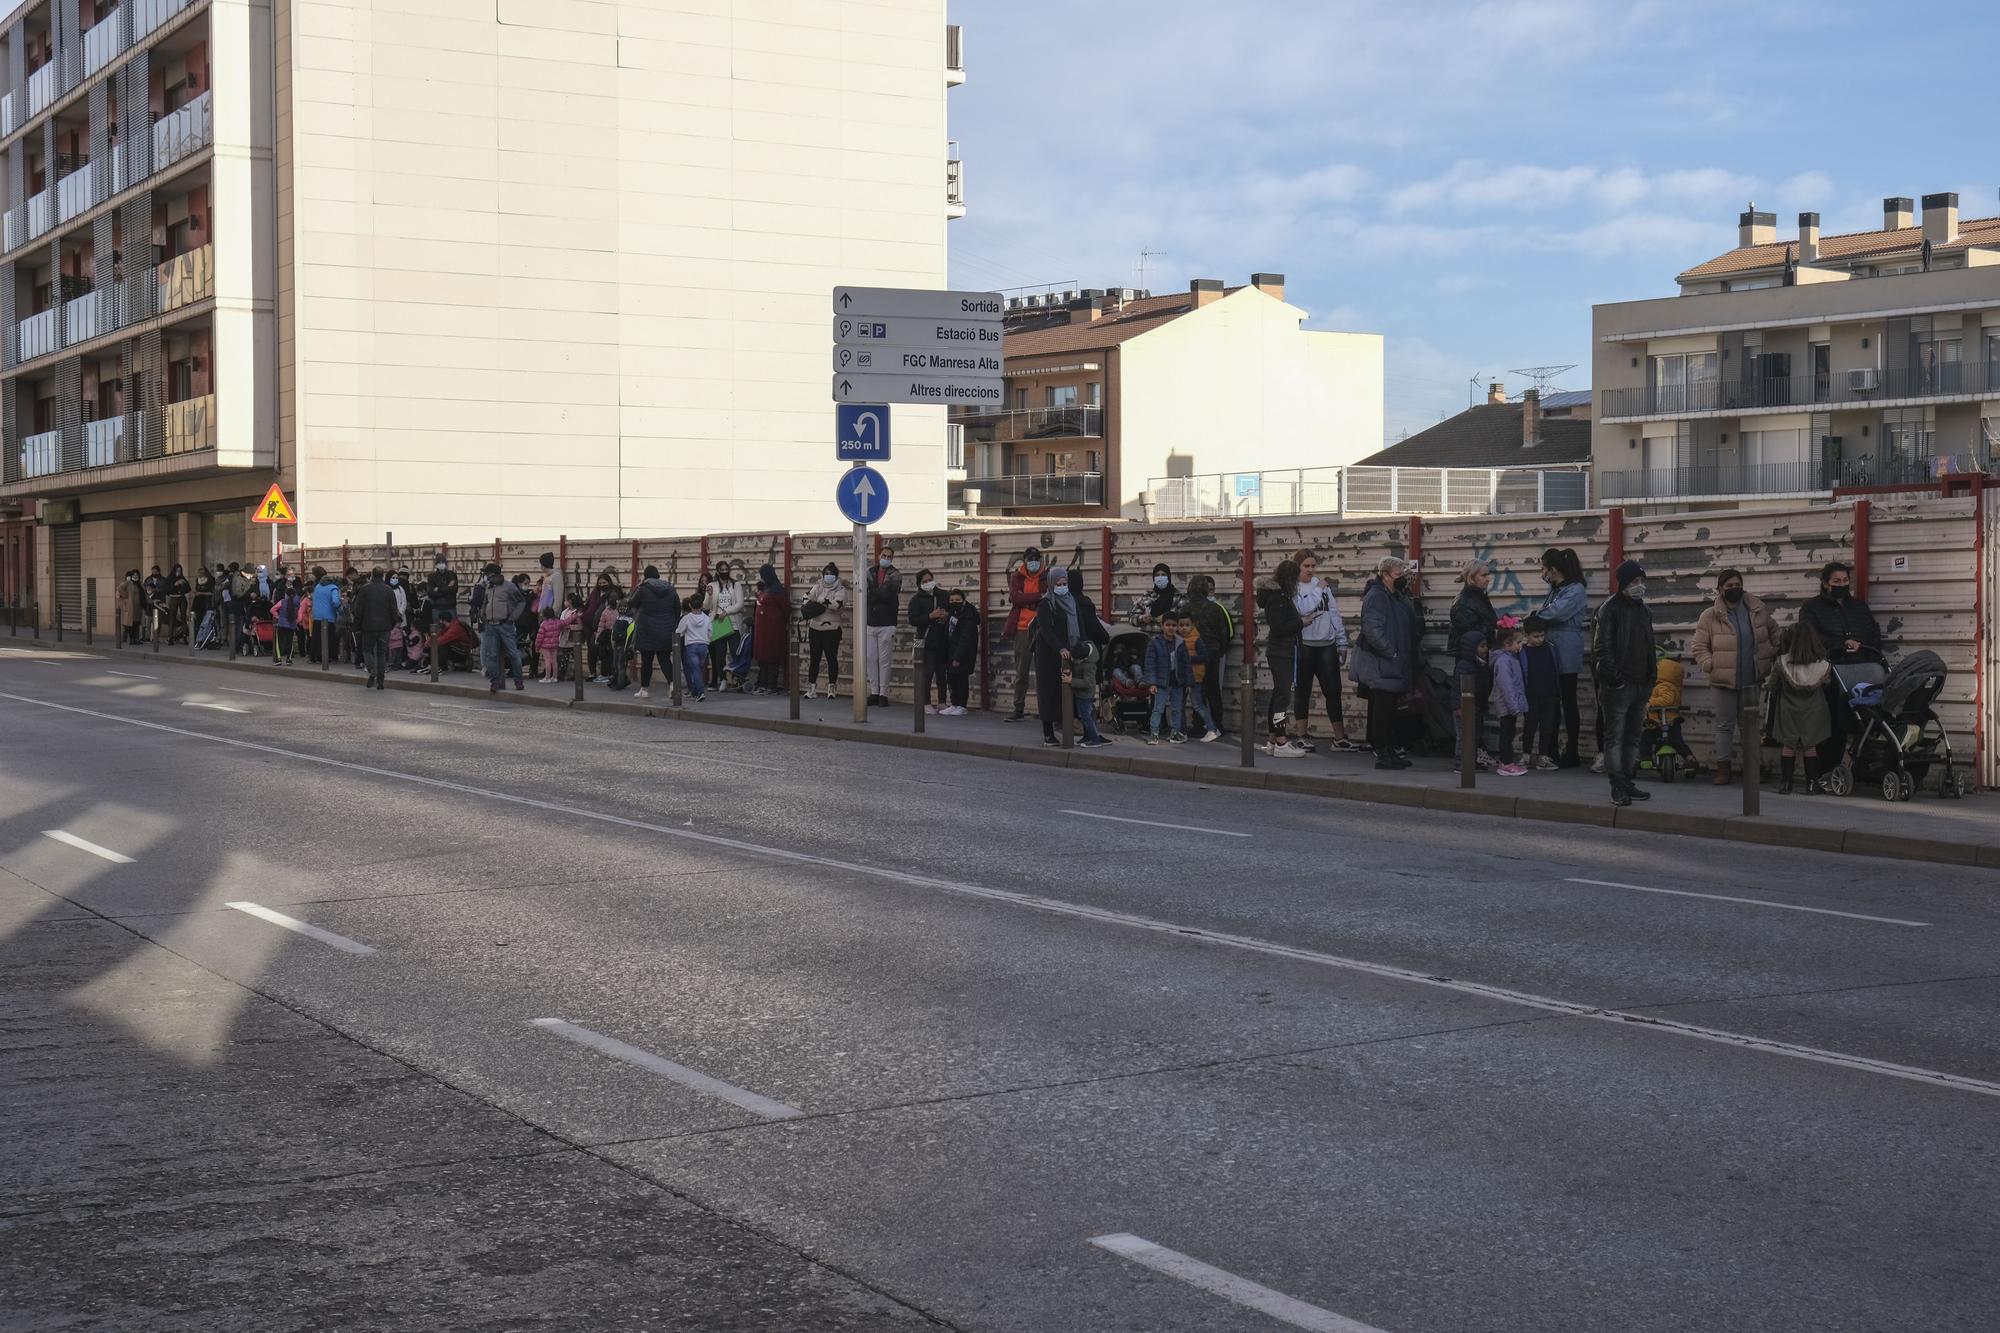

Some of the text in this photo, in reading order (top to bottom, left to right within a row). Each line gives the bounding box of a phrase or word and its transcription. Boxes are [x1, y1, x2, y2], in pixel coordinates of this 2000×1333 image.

[961, 299, 999, 313] Sortida
[936, 327, 999, 341] Estació Bus
[903, 354, 999, 370] FGC Manresa Alta
[910, 384, 1000, 399] Altres direccions
[841, 440, 873, 450] 250 m
